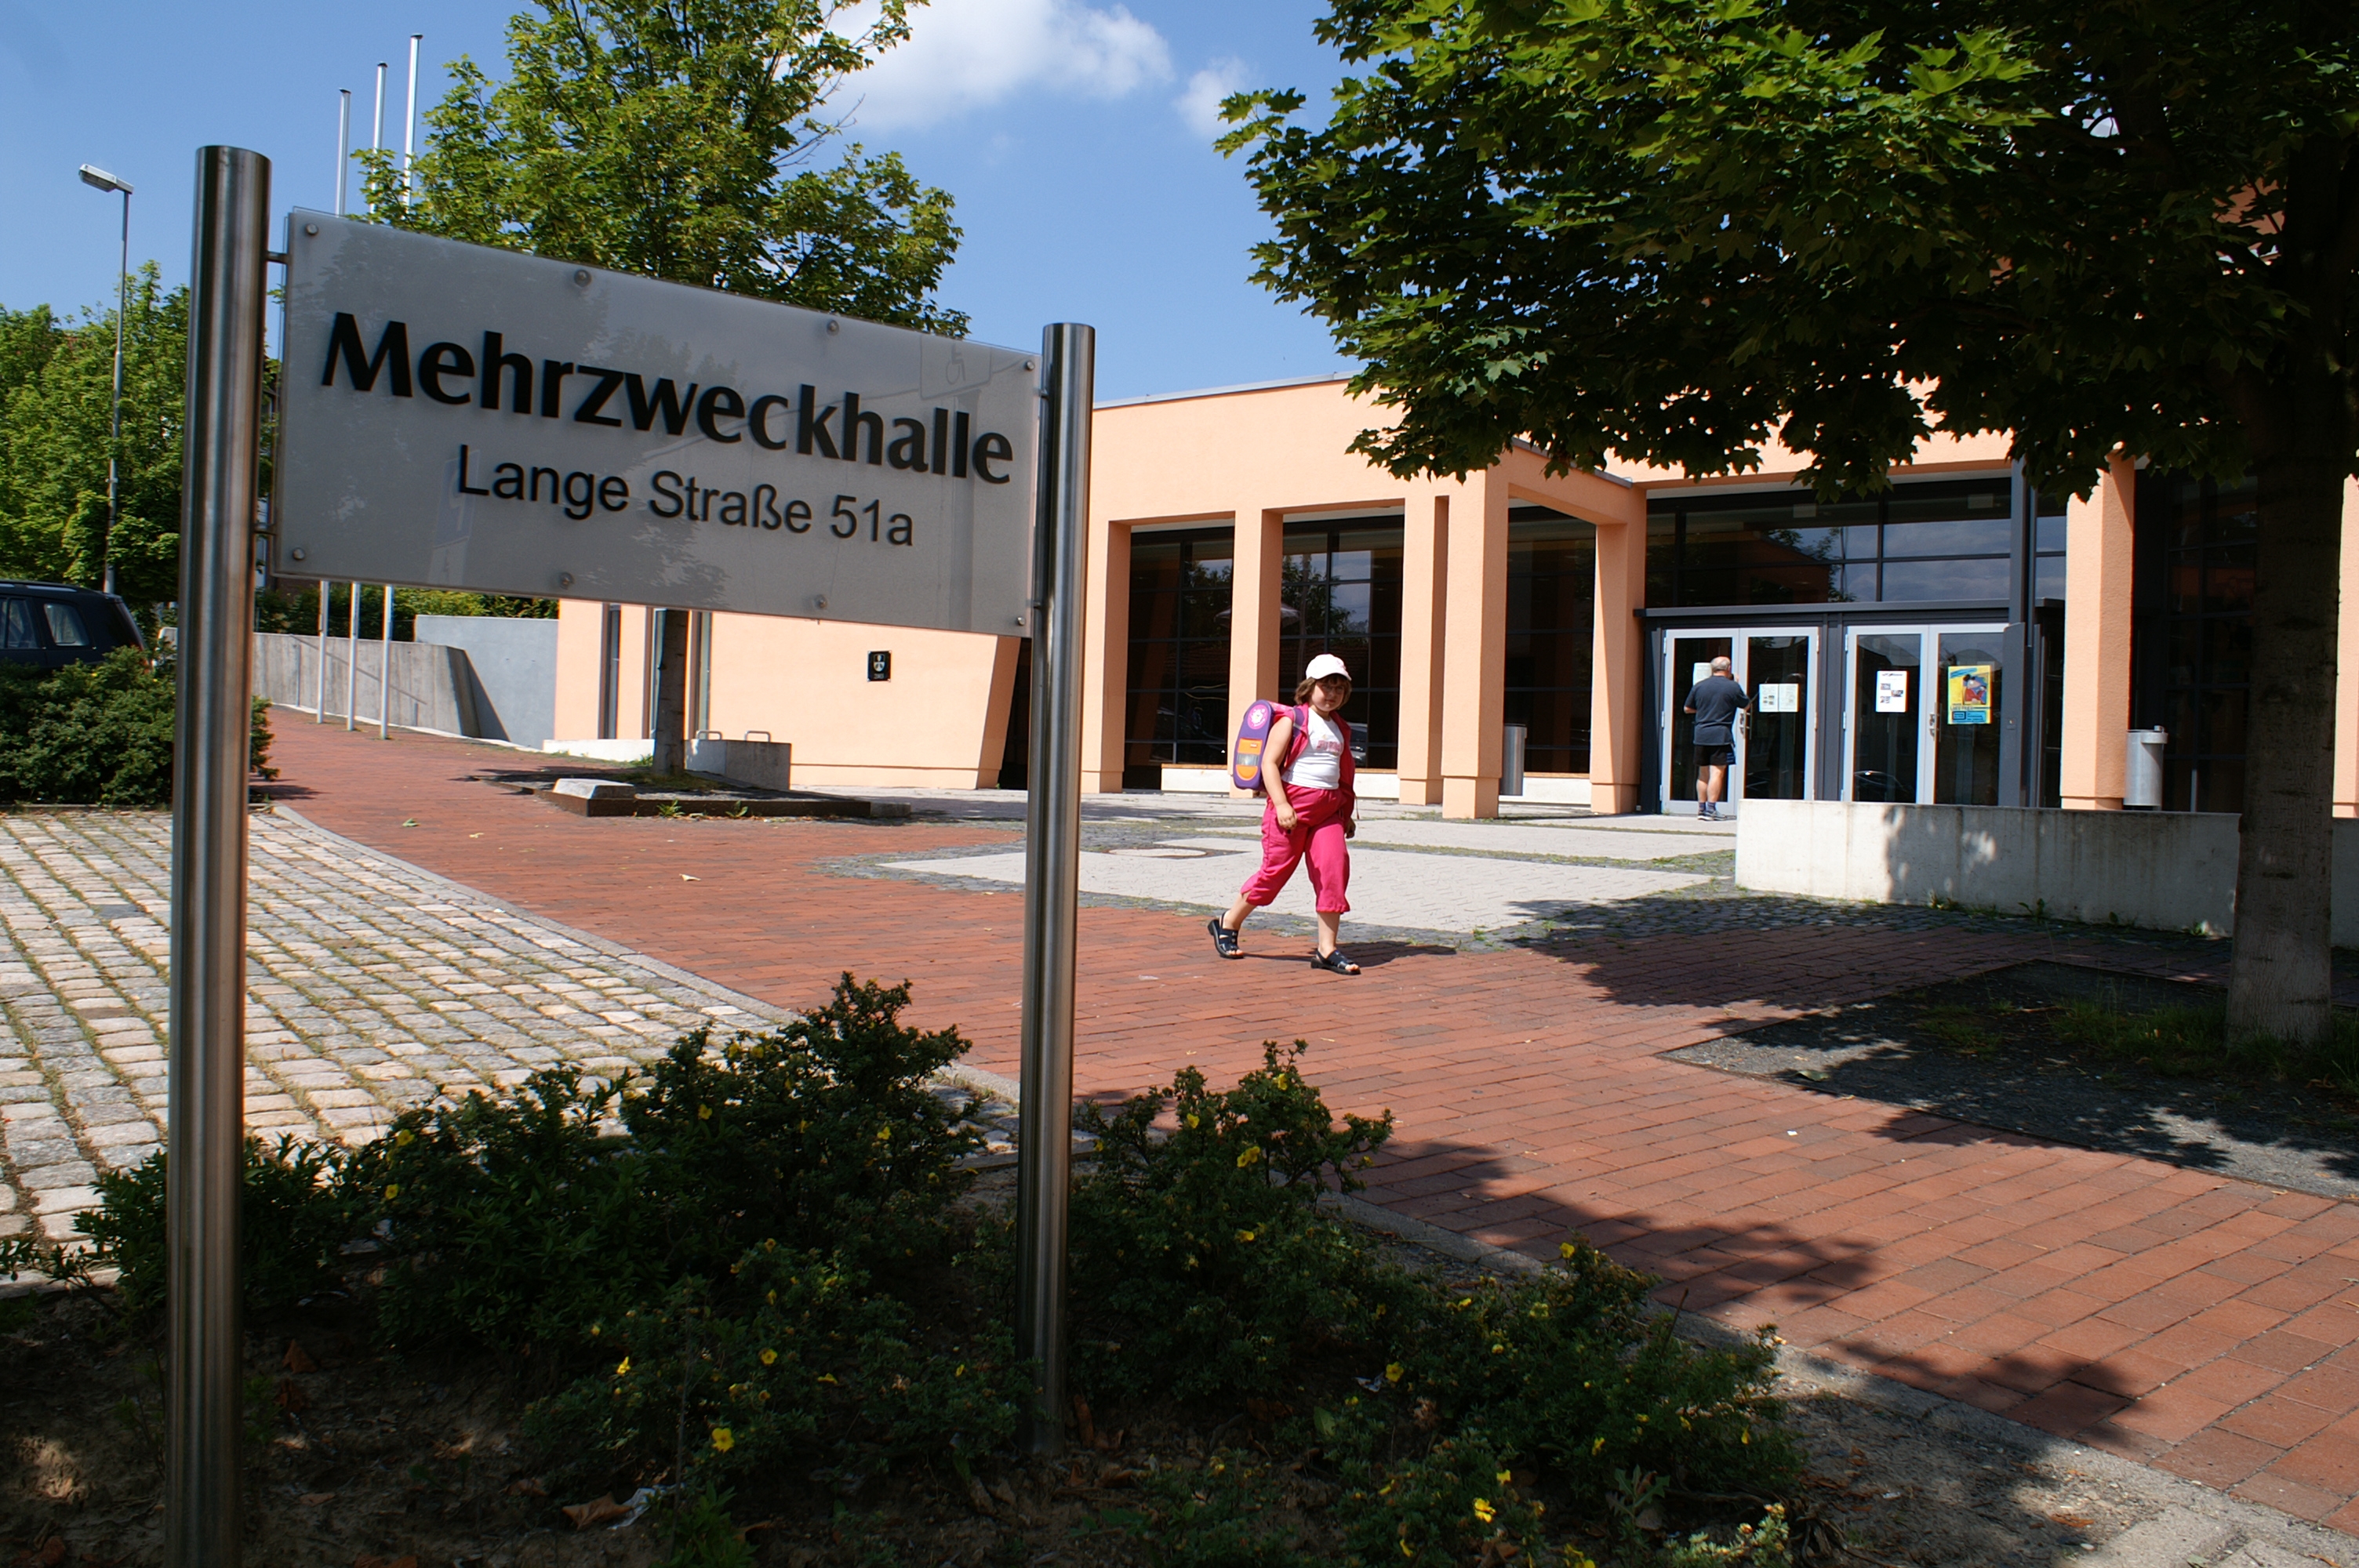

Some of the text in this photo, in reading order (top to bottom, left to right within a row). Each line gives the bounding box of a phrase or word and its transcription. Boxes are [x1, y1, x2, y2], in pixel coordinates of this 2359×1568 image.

[320, 312, 1013, 485] Mehrzweckhalle
[457, 445, 913, 546] Lange Straße 51a
